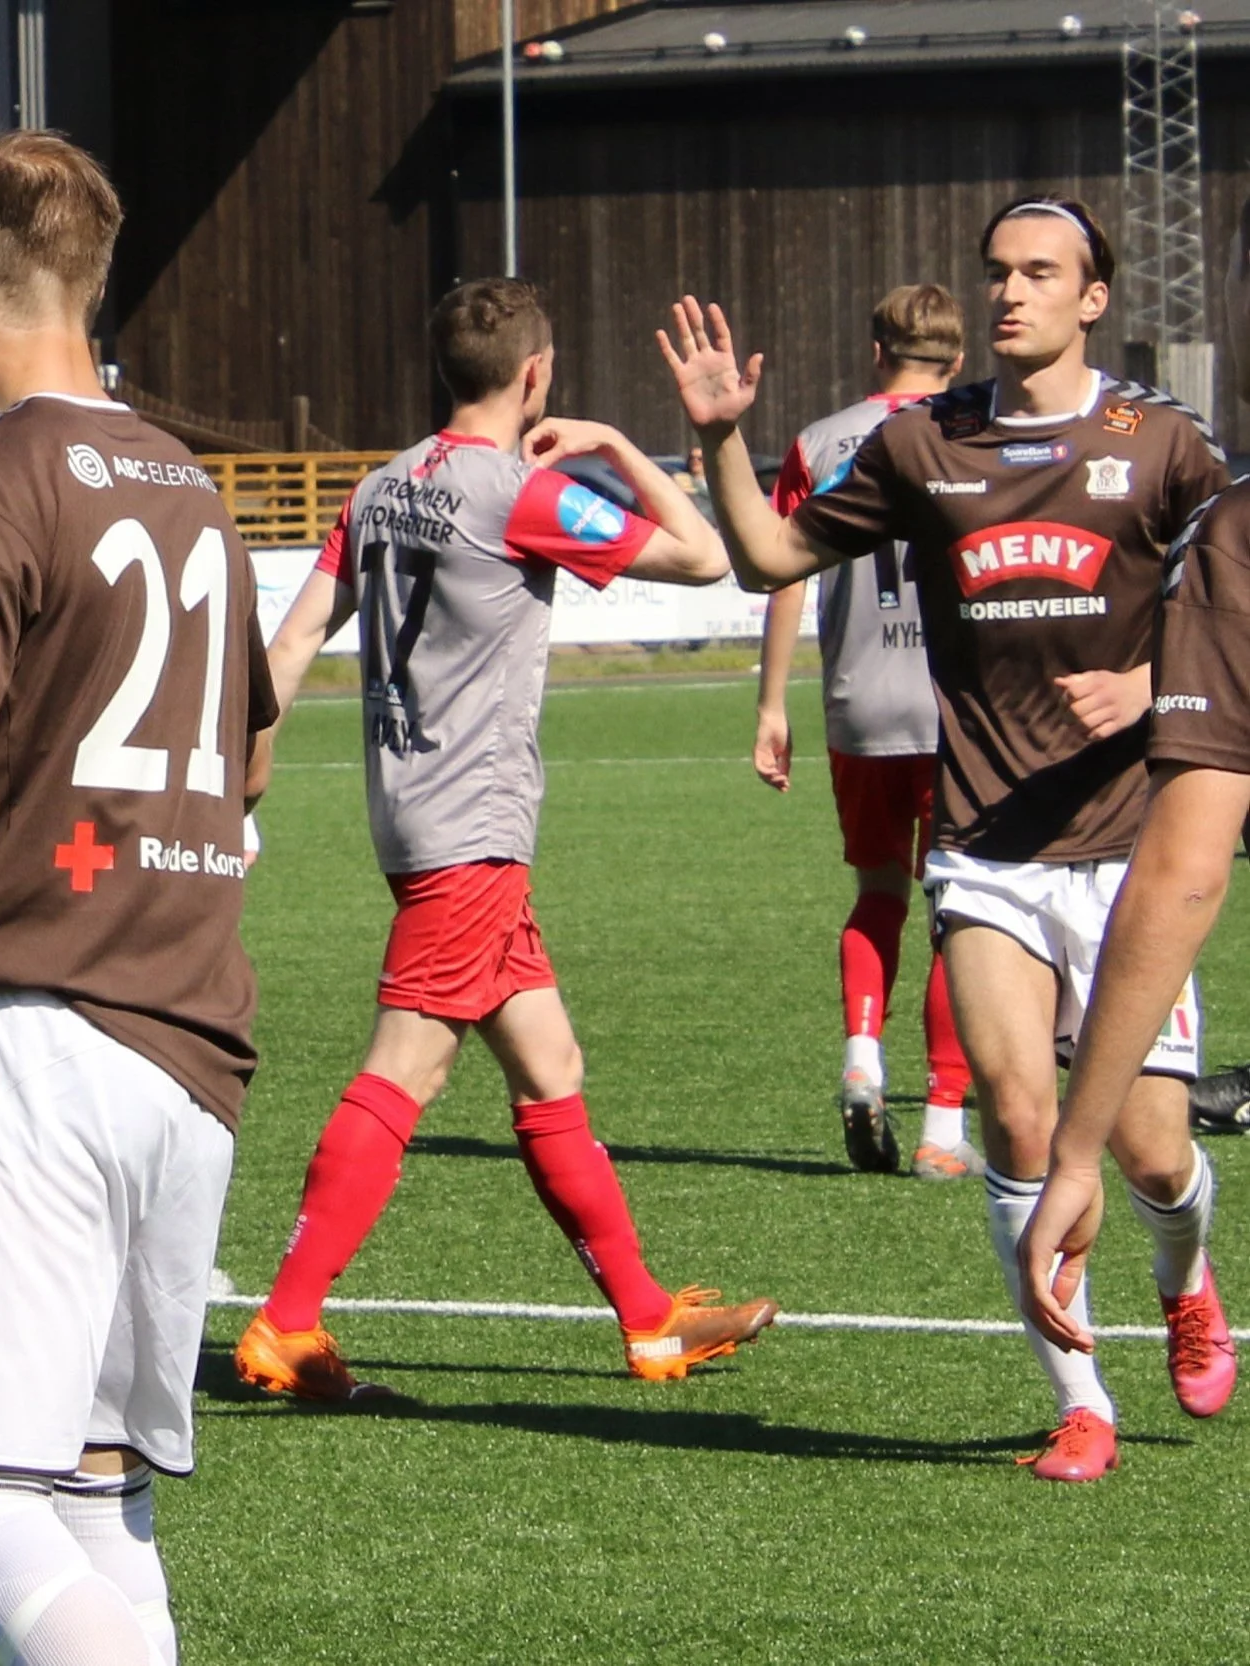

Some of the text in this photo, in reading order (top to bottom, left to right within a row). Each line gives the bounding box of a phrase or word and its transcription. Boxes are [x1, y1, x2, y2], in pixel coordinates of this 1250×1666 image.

[113, 455, 149, 482] ABC
[940, 480, 987, 494] hummel
[960, 534, 1094, 578] MENY
[960, 596, 1106, 620] BORREVEIEN
[882, 622, 925, 648] MYH
[71, 518, 228, 798] 21
[203, 842, 244, 879] Kors
